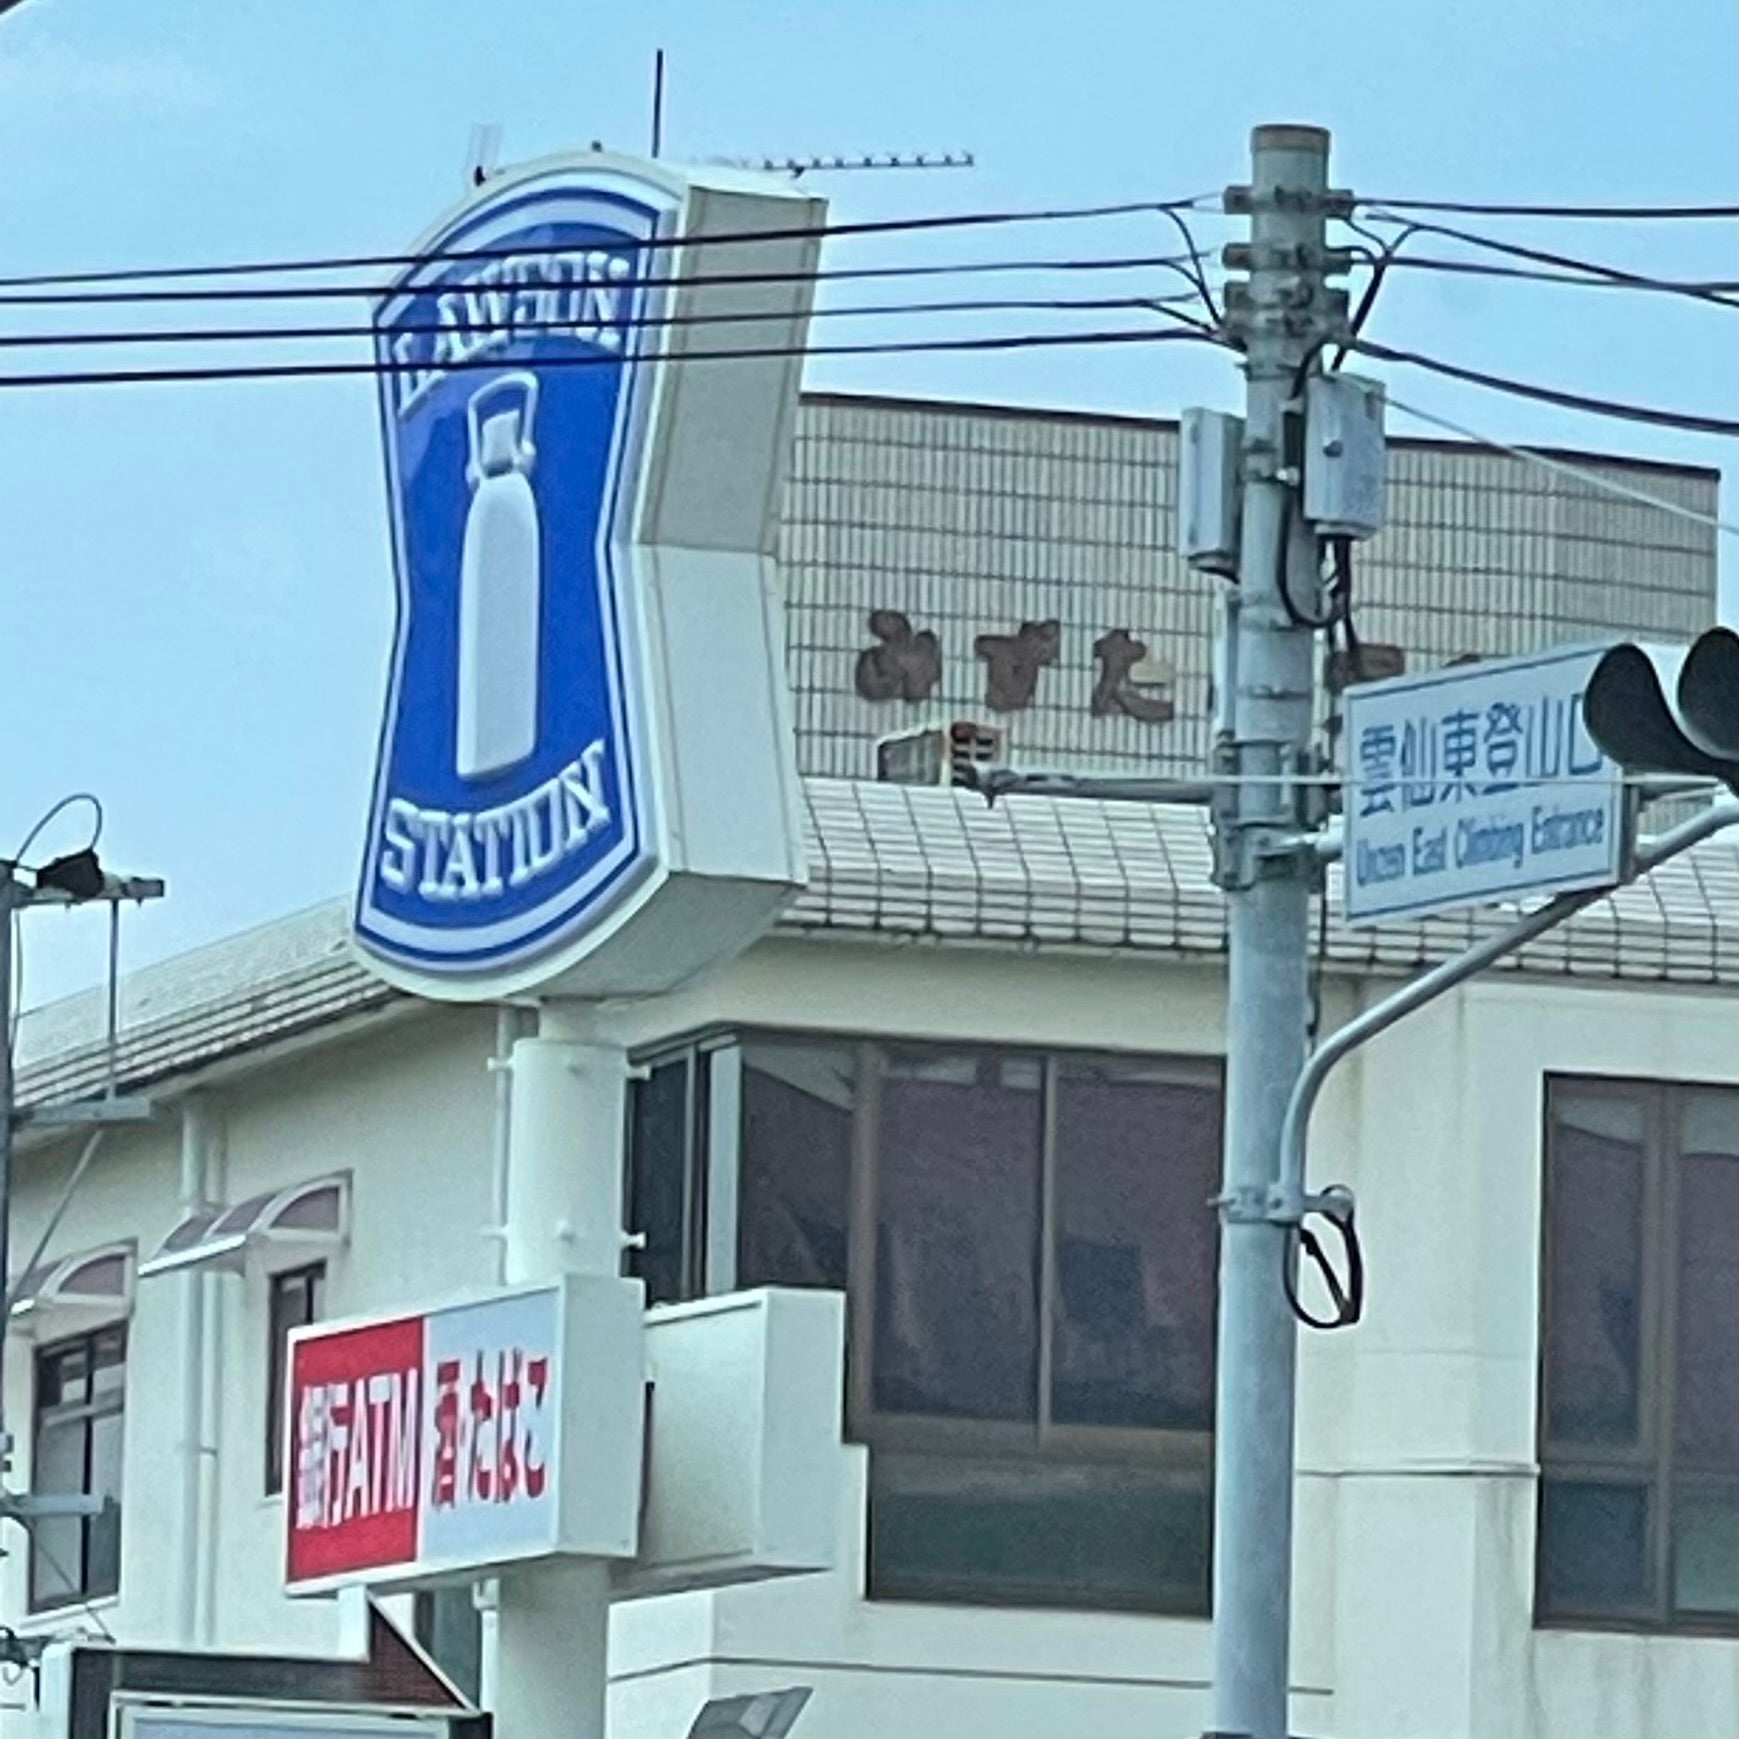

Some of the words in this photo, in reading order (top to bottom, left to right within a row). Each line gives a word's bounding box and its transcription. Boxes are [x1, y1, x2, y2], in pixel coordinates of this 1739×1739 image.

[381, 738, 610, 902] STATION
[1356, 836, 1405, 886] Unzen
[1412, 825, 1447, 876] East
[1454, 814, 1524, 869] Climbing
[1531, 805, 1604, 854] Entrance
